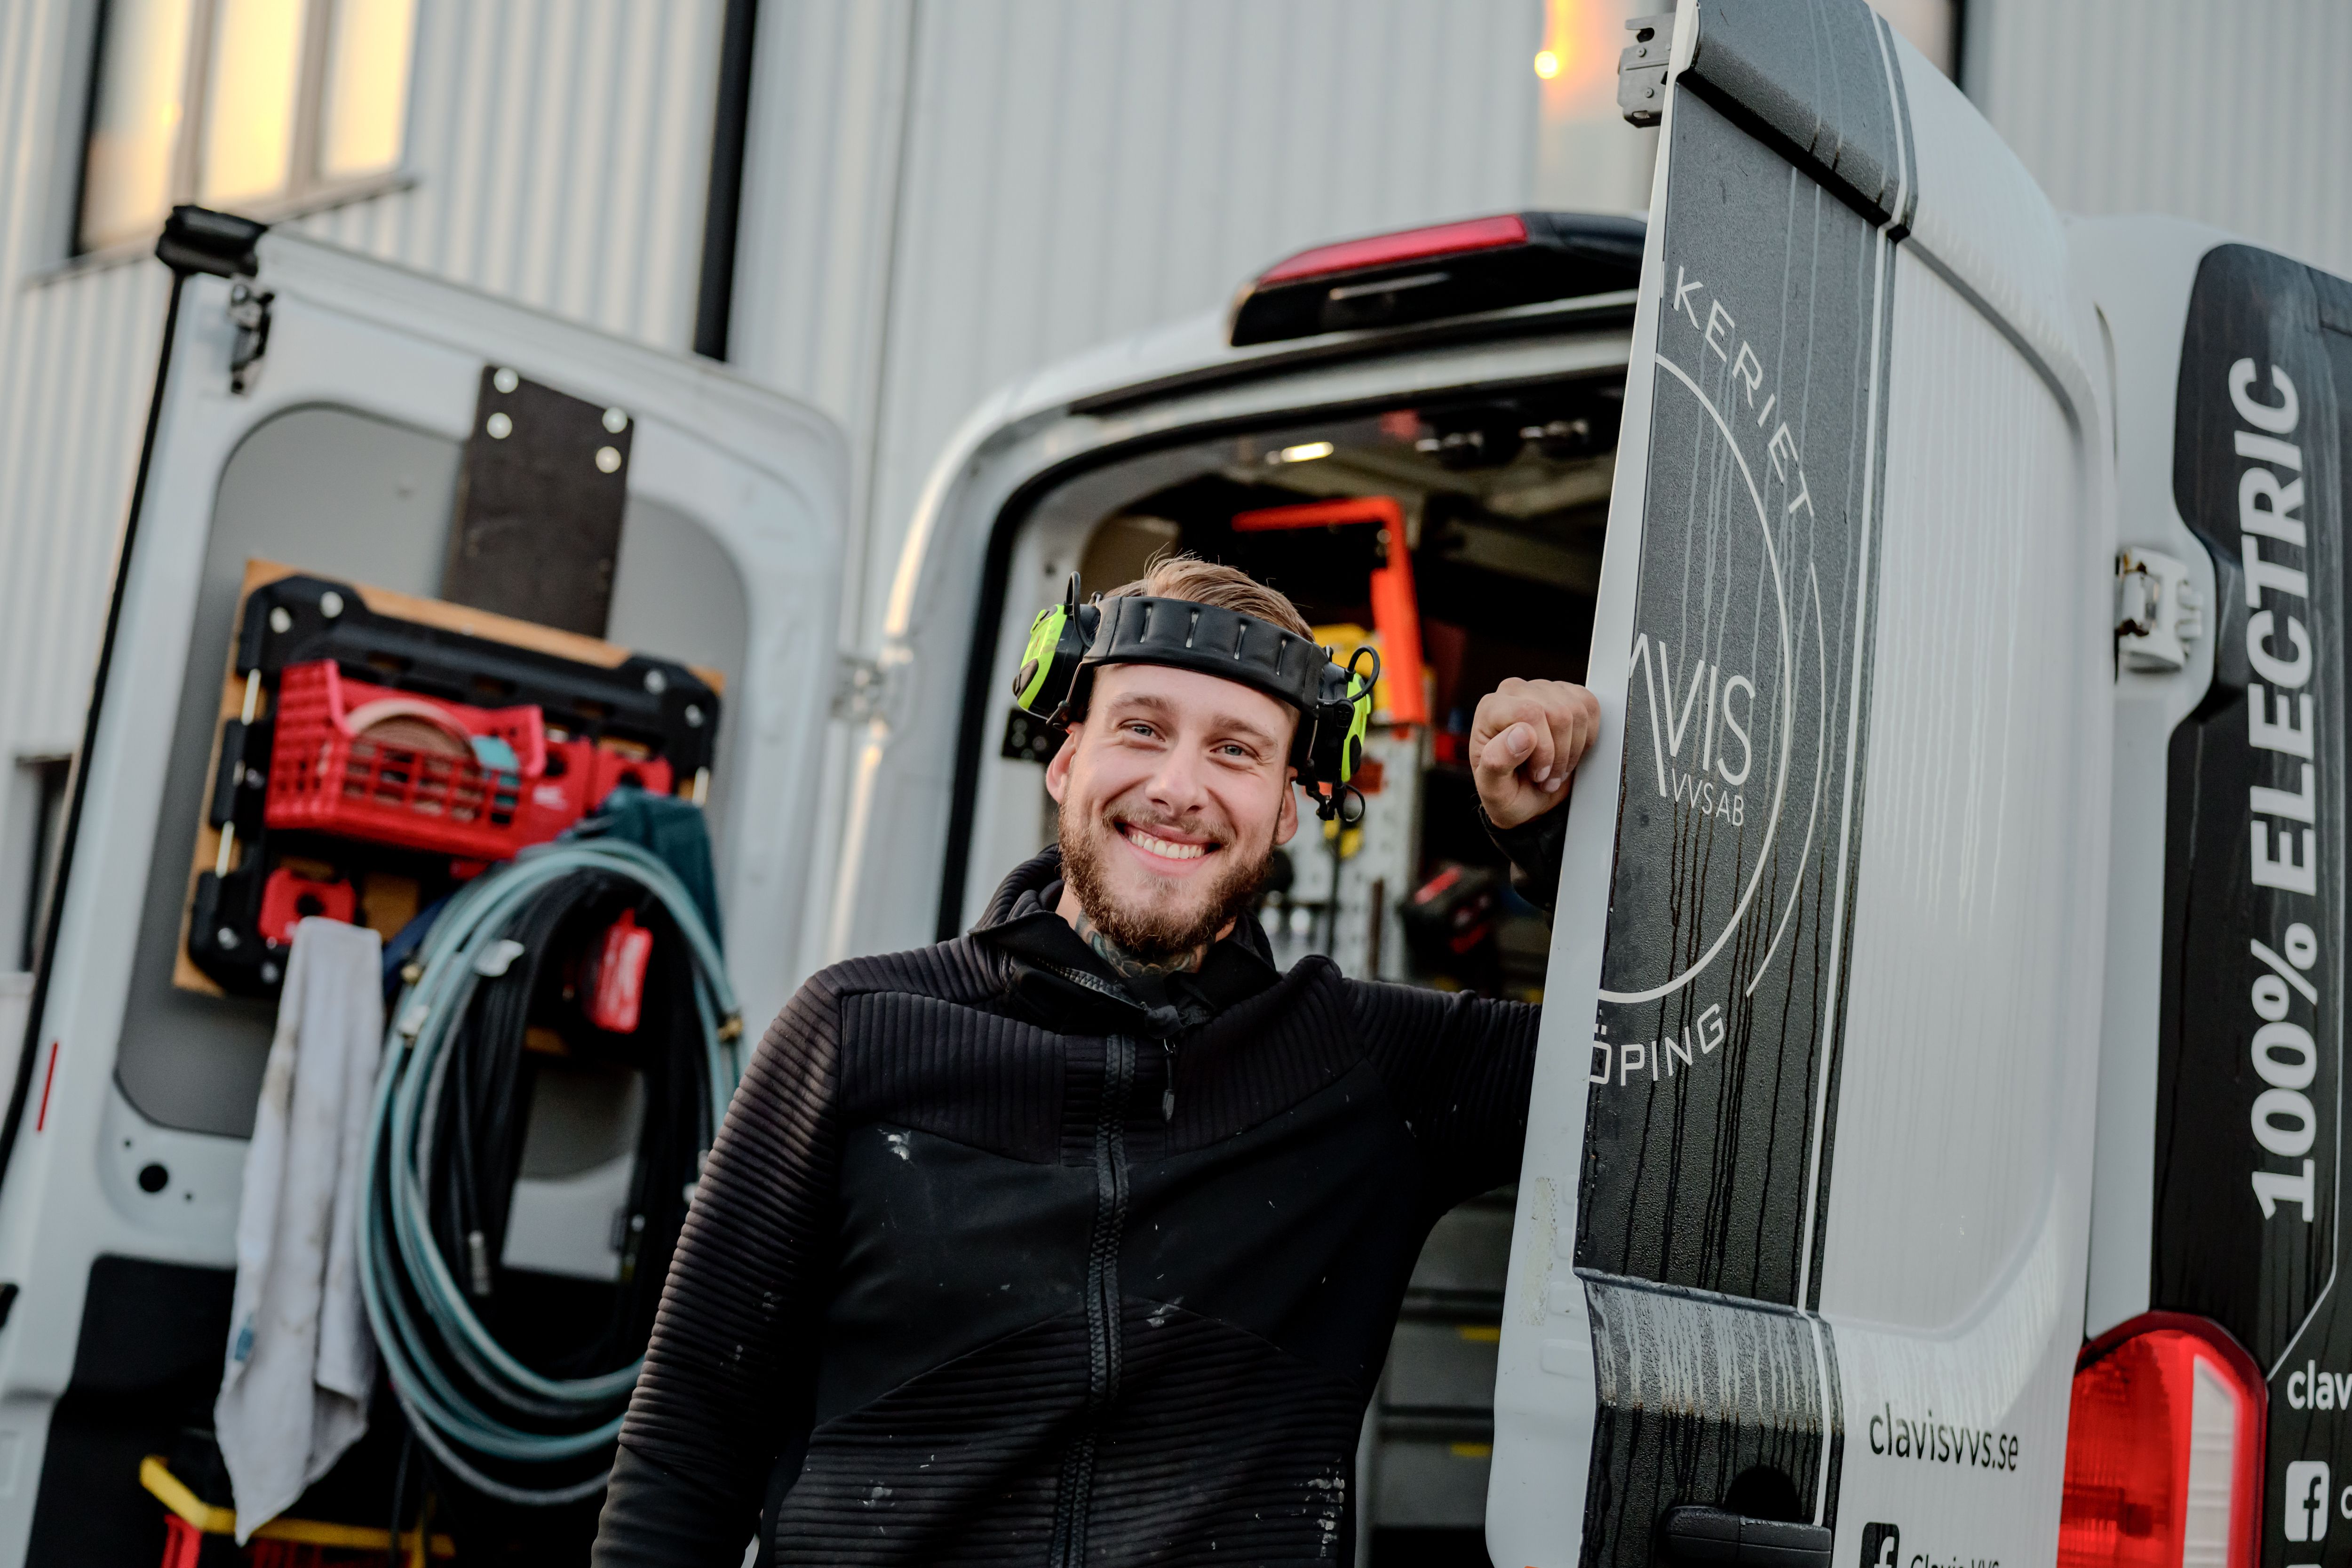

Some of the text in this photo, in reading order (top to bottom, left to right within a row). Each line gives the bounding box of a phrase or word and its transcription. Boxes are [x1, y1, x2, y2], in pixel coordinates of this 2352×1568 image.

[1661, 261, 1814, 517] KERIET
[2228, 357, 2318, 1223] 100% ELECTRIC
[1869, 1401, 2018, 1472] clavisvvs.se
